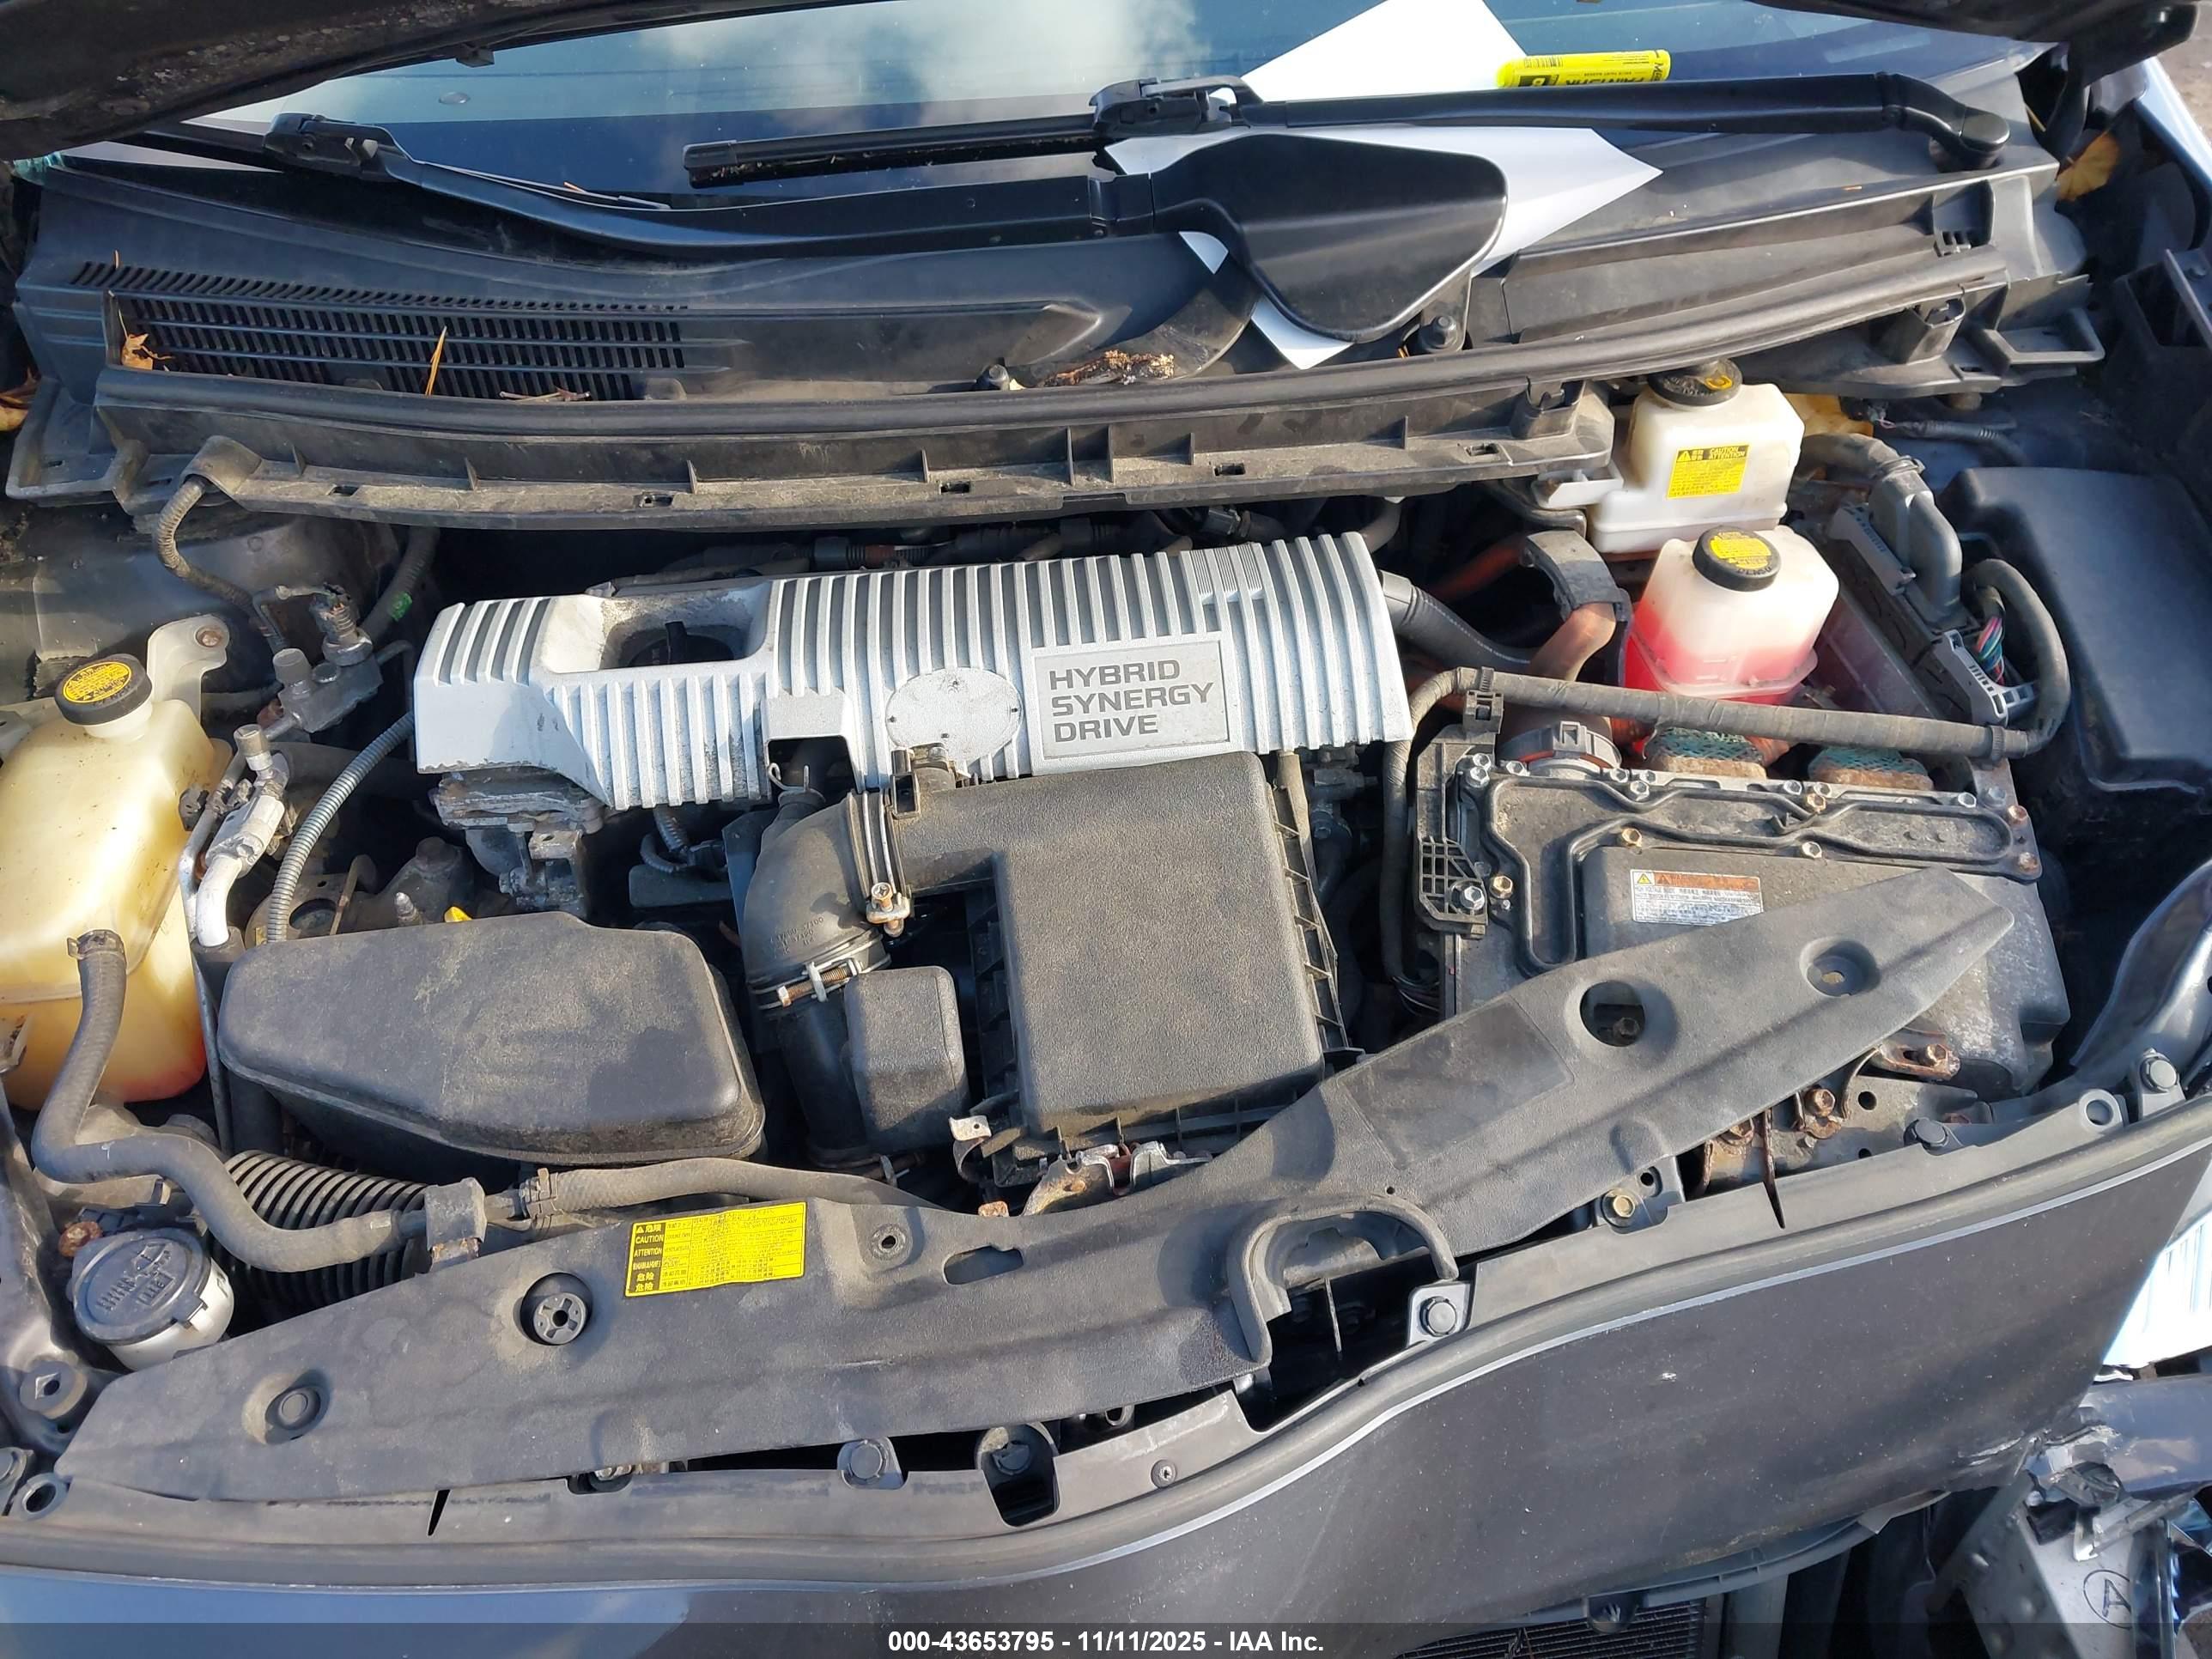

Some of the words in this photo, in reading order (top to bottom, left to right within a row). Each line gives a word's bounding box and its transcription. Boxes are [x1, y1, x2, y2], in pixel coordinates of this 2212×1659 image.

[1708, 451, 1746, 460] ATTENTION
[1710, 446, 1739, 454] CAUTION
[1049, 659, 1181, 690] HYBRID
[1051, 682, 1214, 717] SYNERGY
[1054, 714, 1158, 743] DRIVE
[635, 1234, 664, 1244] CAUTION
[634, 1248, 662, 1258] ATTENTION
[2101, 1578, 2132, 1618] A
